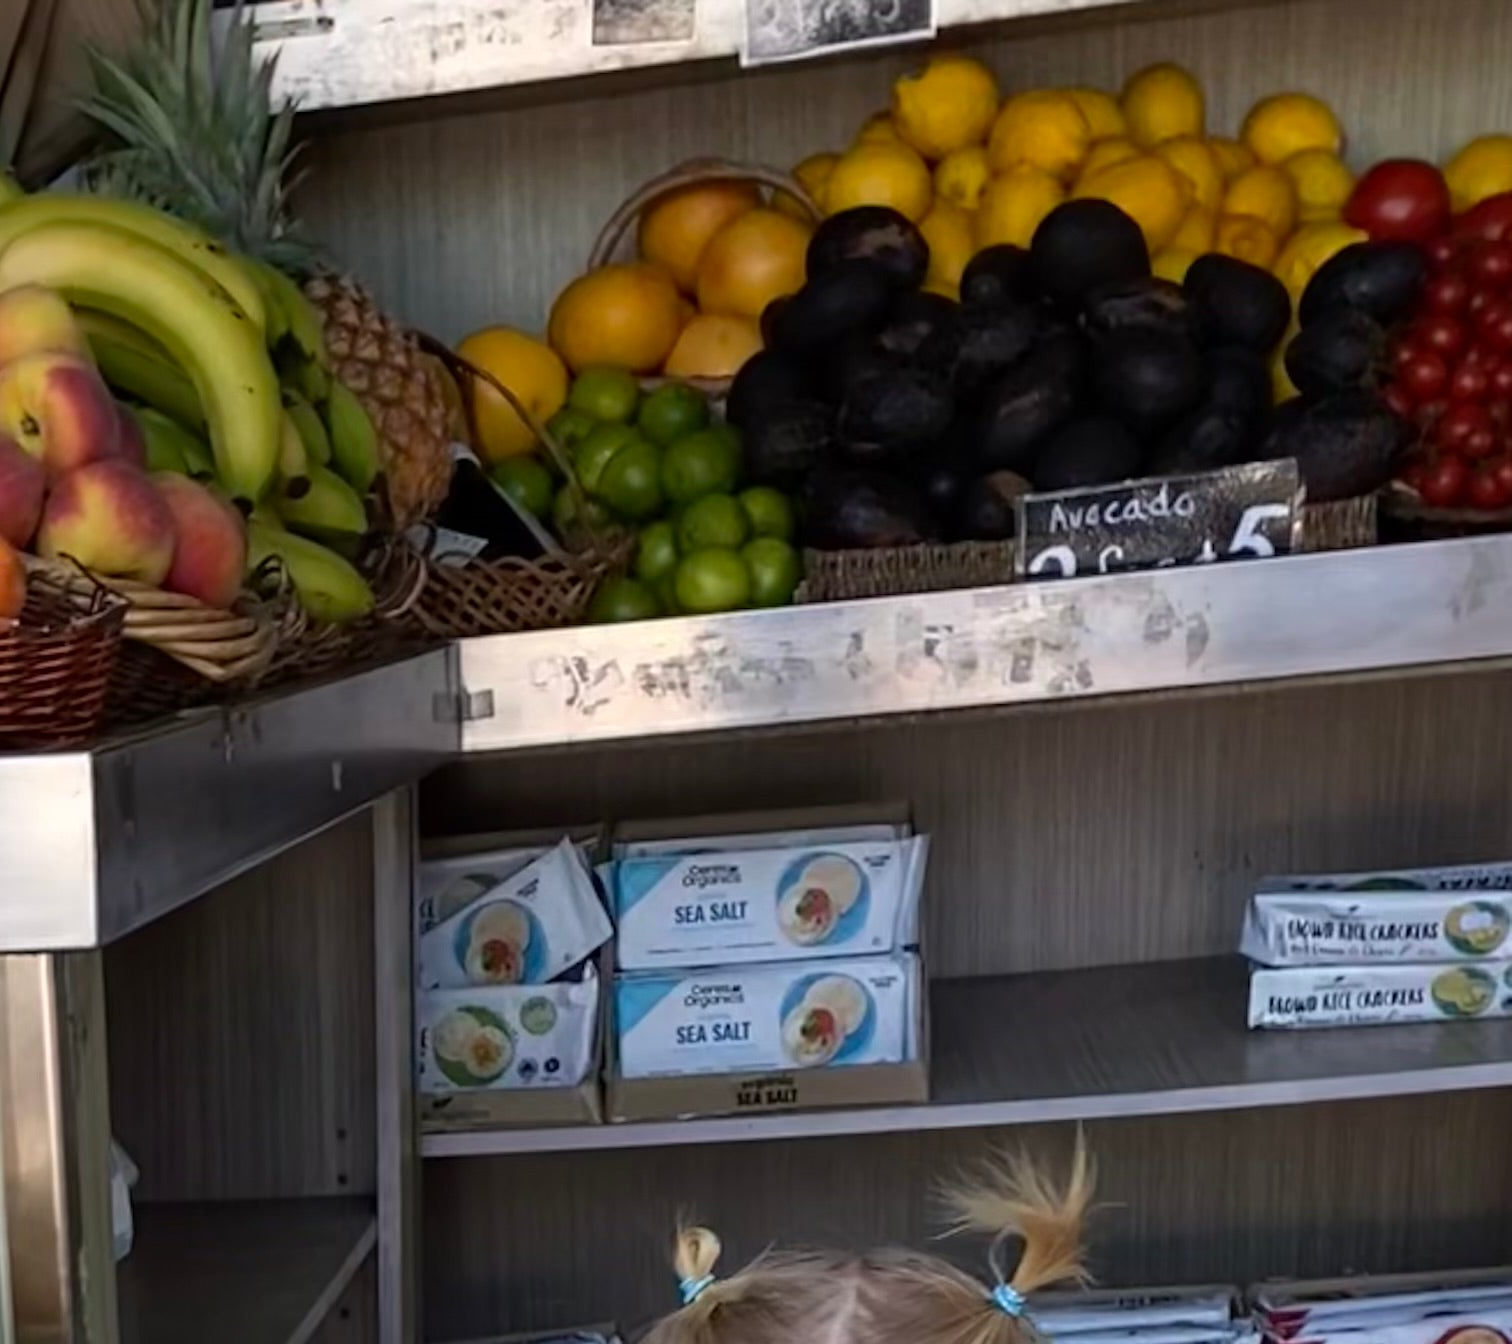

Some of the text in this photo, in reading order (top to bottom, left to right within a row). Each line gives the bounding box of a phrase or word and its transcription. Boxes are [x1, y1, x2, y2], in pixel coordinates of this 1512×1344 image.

[1050, 482, 1195, 533] Avocado
[674, 900, 748, 924] SEA SALT
[1322, 990, 1351, 1011] RICE
[1356, 987, 1424, 1009] CRACKERS
[676, 1021, 752, 1044] SEA SALT
[766, 1088, 798, 1105] SALT
